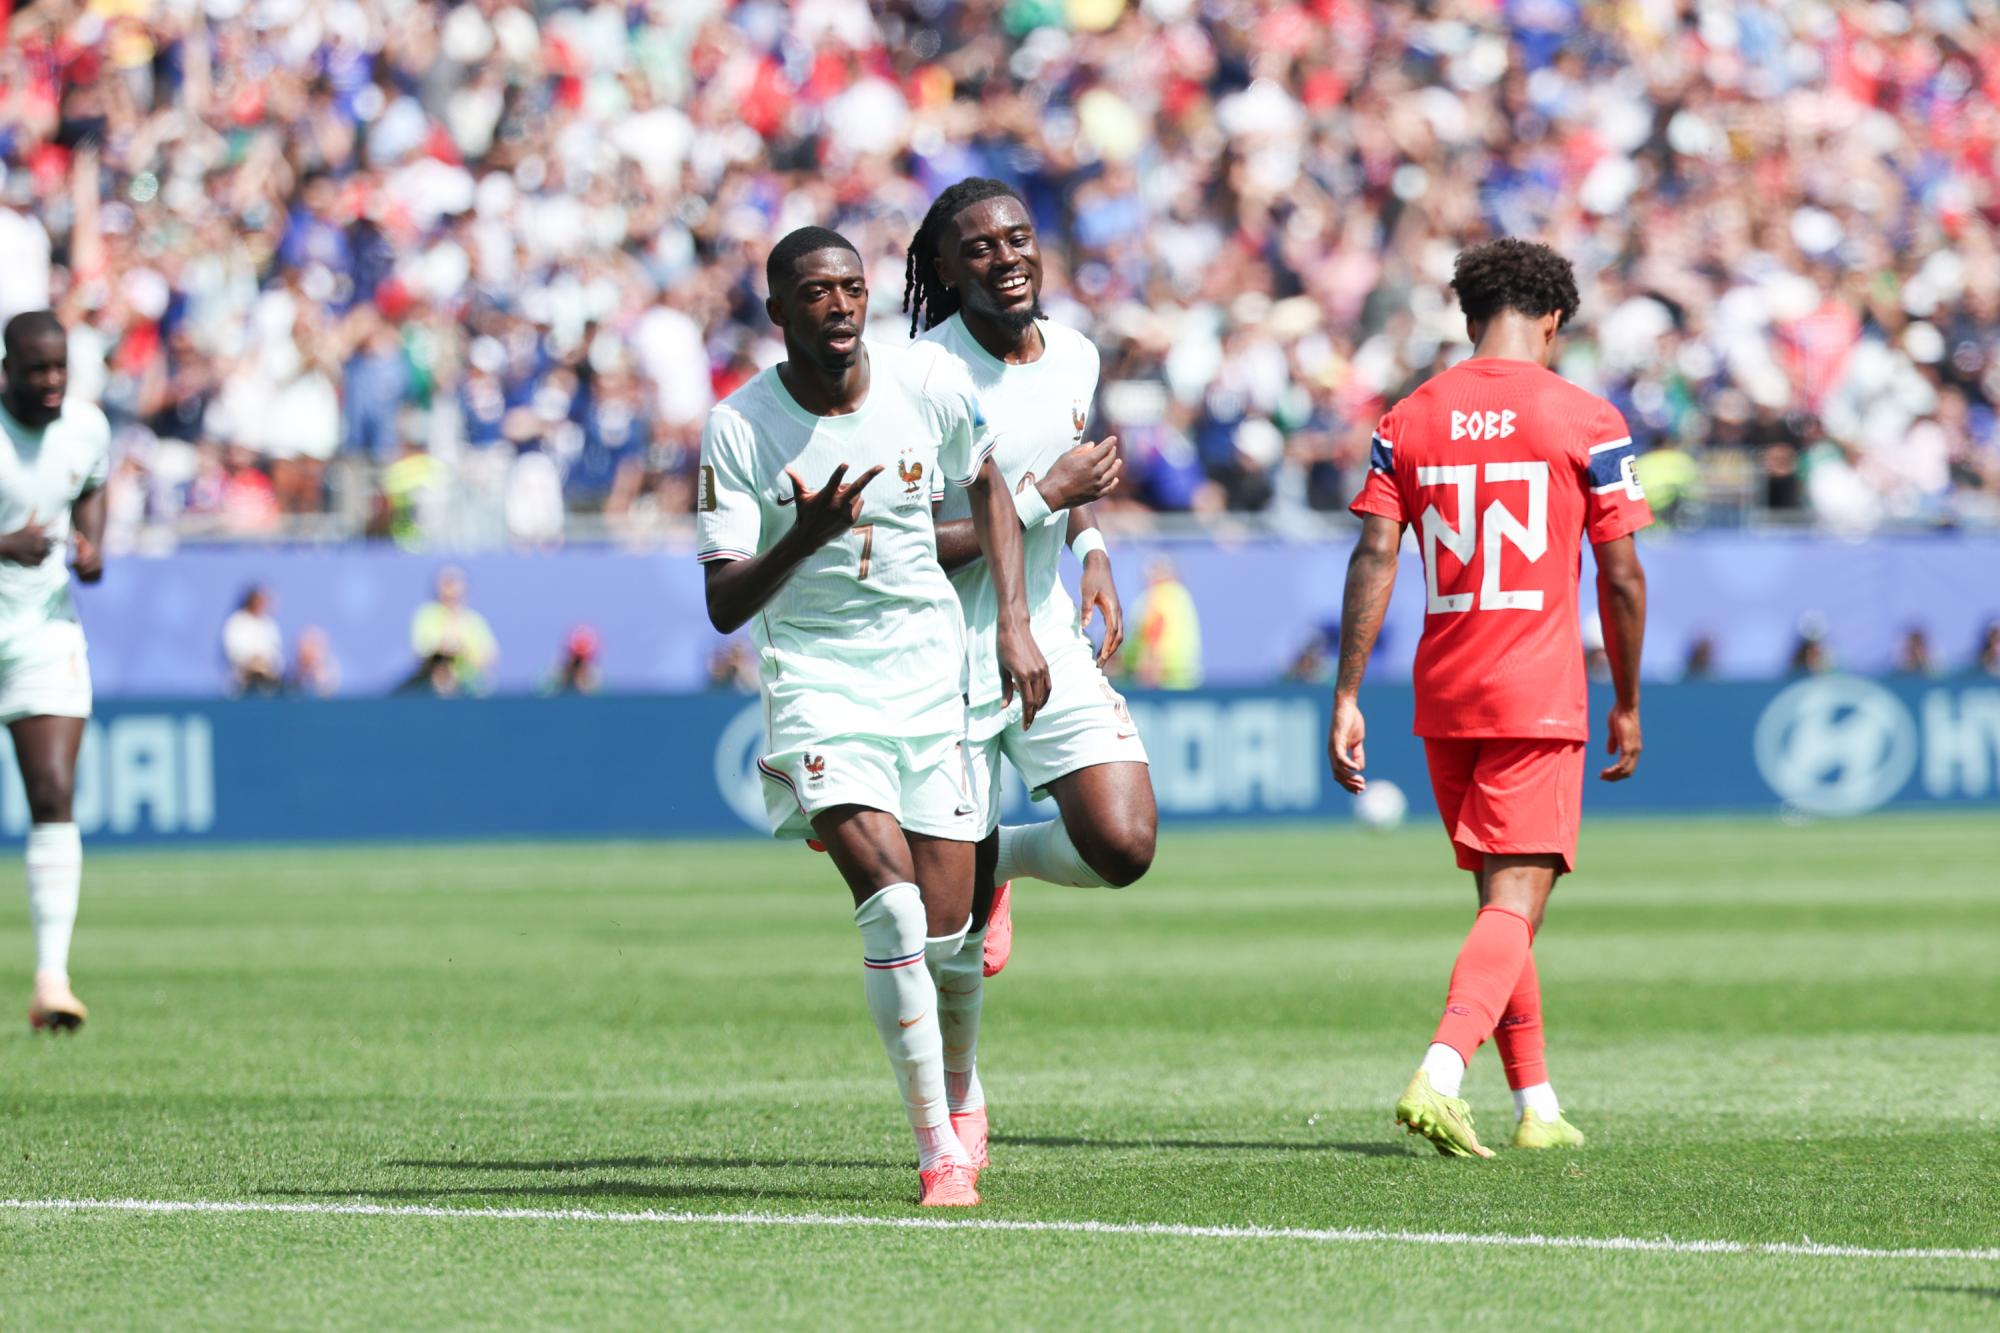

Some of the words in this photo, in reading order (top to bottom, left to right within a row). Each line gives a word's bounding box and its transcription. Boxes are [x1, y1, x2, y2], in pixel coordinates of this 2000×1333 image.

[1451, 409, 1517, 441] BOBB
[852, 523, 874, 581] 7
[1417, 461, 1549, 614] 22
